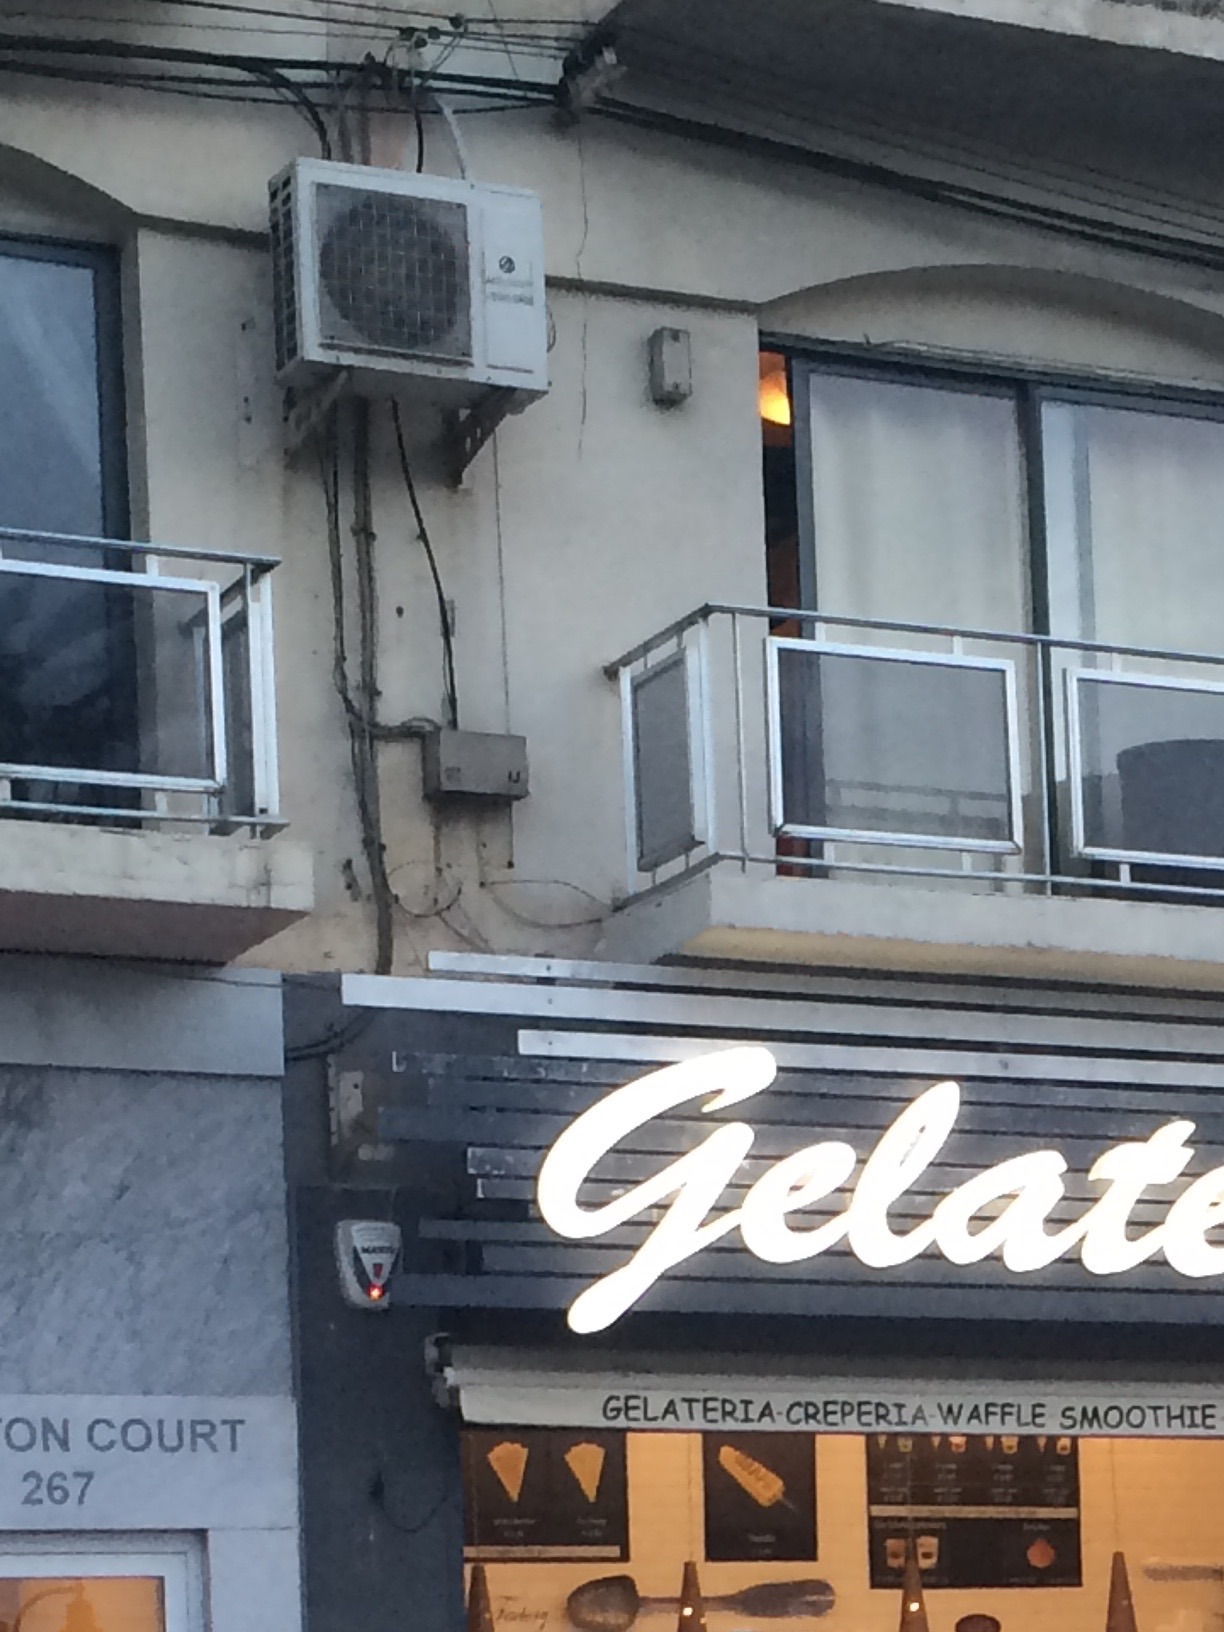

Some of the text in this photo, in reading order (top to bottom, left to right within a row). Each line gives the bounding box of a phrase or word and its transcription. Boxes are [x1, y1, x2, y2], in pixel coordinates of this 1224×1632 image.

[0, 1416, 246, 1453] ON COURT
[21, 1470, 95, 1506] 267
